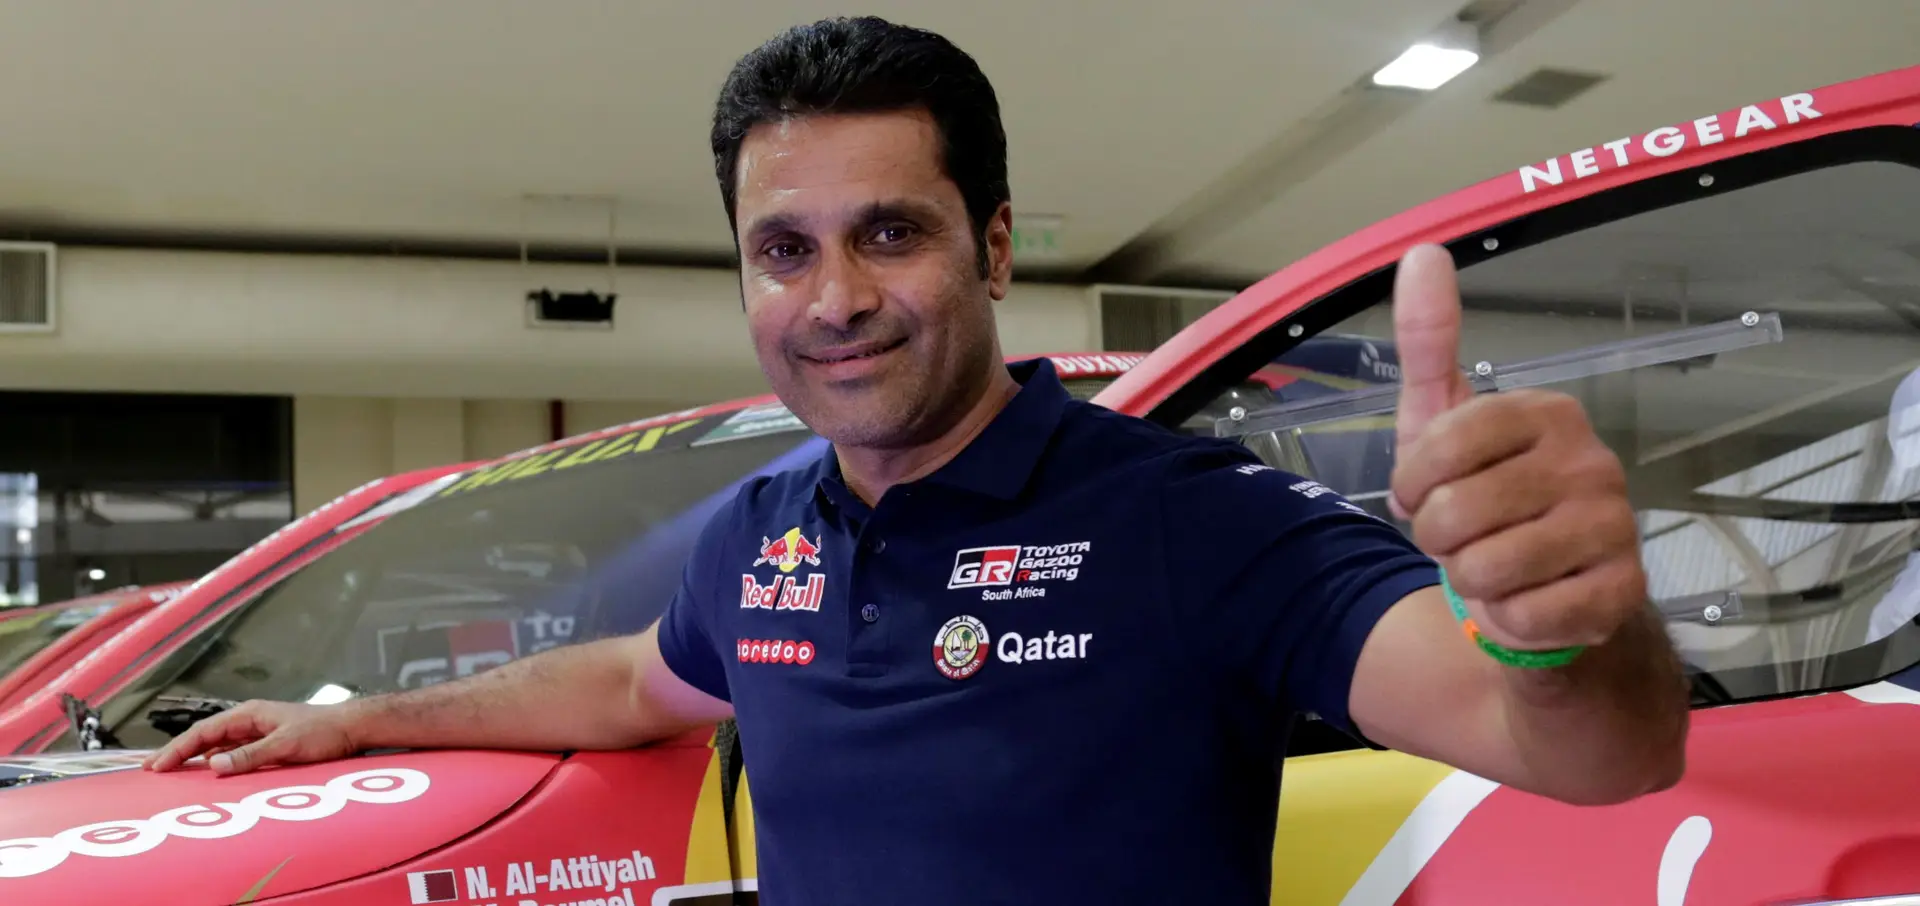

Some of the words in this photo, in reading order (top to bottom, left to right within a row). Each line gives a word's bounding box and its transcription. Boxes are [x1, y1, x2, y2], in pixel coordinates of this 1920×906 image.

[1519, 92, 1823, 193] NETGEAR
[1022, 541, 1091, 557] TOYOTA
[953, 560, 1012, 584] GR
[1018, 554, 1083, 569] GAZOO
[1015, 567, 1079, 582] Racing
[740, 573, 783, 610] Red
[776, 573, 826, 612] Bull
[981, 589, 1013, 601] South
[1014, 586, 1046, 599] Africa
[997, 630, 1093, 664] Qatar
[464, 866, 498, 900] N.
[506, 850, 656, 897] Al-Attiyah
